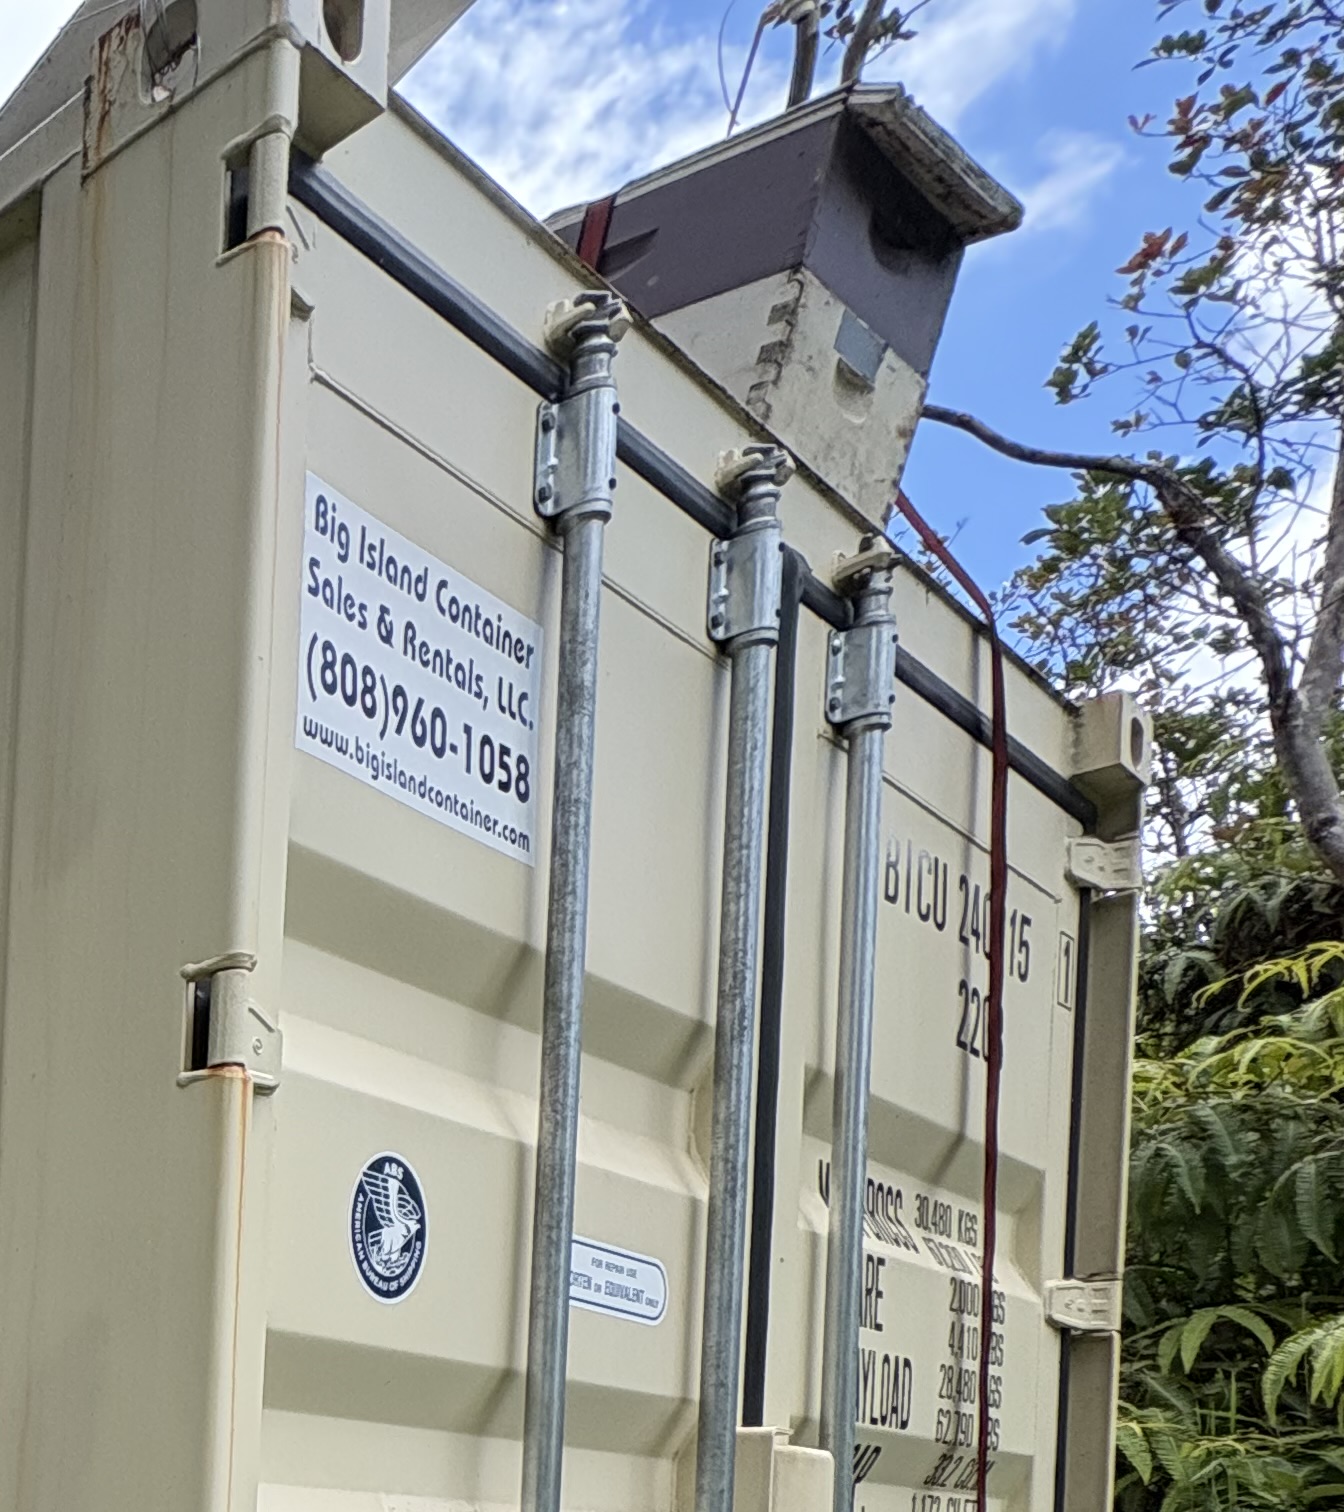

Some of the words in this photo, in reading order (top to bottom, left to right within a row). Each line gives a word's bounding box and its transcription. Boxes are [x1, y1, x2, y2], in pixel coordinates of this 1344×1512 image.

[314, 494, 351, 564] Big
[359, 524, 429, 603] Island
[435, 579, 535, 670] Container
[307, 556, 368, 631] Sales
[376, 603, 395, 648] &
[402, 620, 489, 712] Rentals,
[498, 675, 534, 731] LLC.
[307, 631, 531, 804] (808)960-1058
[303, 715, 531, 853] www.bigislandcontainer.com
[884, 835, 947, 932] BICU
[383, 1161, 404, 1181] ABS
[354, 1192, 366, 1261] AMERICAN
[361, 1260, 389, 1291] BUREAU
[862, 1177, 920, 1255] ROSS
[958, 1208, 978, 1247] KGS
[860, 1254, 885, 1332] RE
[991, 1289, 1005, 1325] GS
[856, 1348, 912, 1430] YLOAD
[989, 1374, 1002, 1410] GS
[990, 1331, 1004, 1368] BS
[986, 1417, 999, 1452] BS
